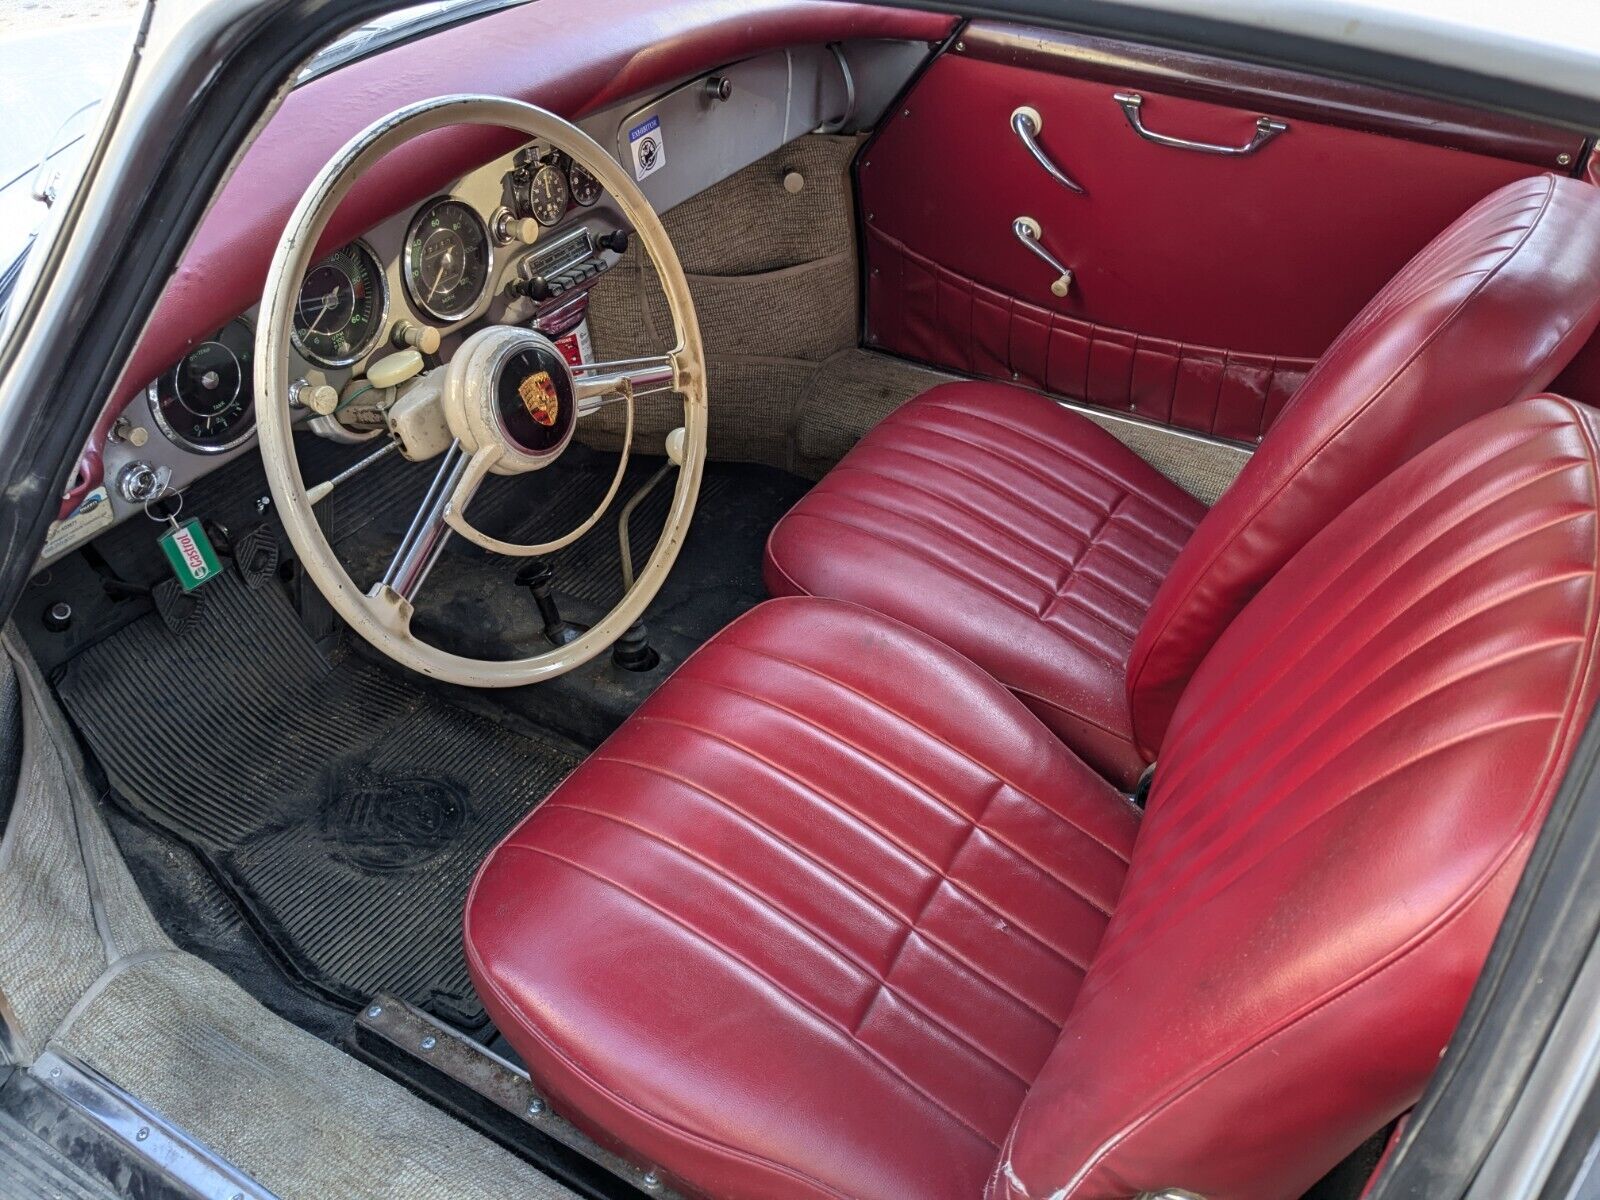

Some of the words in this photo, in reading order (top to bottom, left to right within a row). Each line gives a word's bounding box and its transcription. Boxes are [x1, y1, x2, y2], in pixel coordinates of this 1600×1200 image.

[431, 219, 440, 228] 60
[453, 222, 461, 230] 80
[351, 314, 360, 324] 60
[177, 534, 202, 568] Castrol
